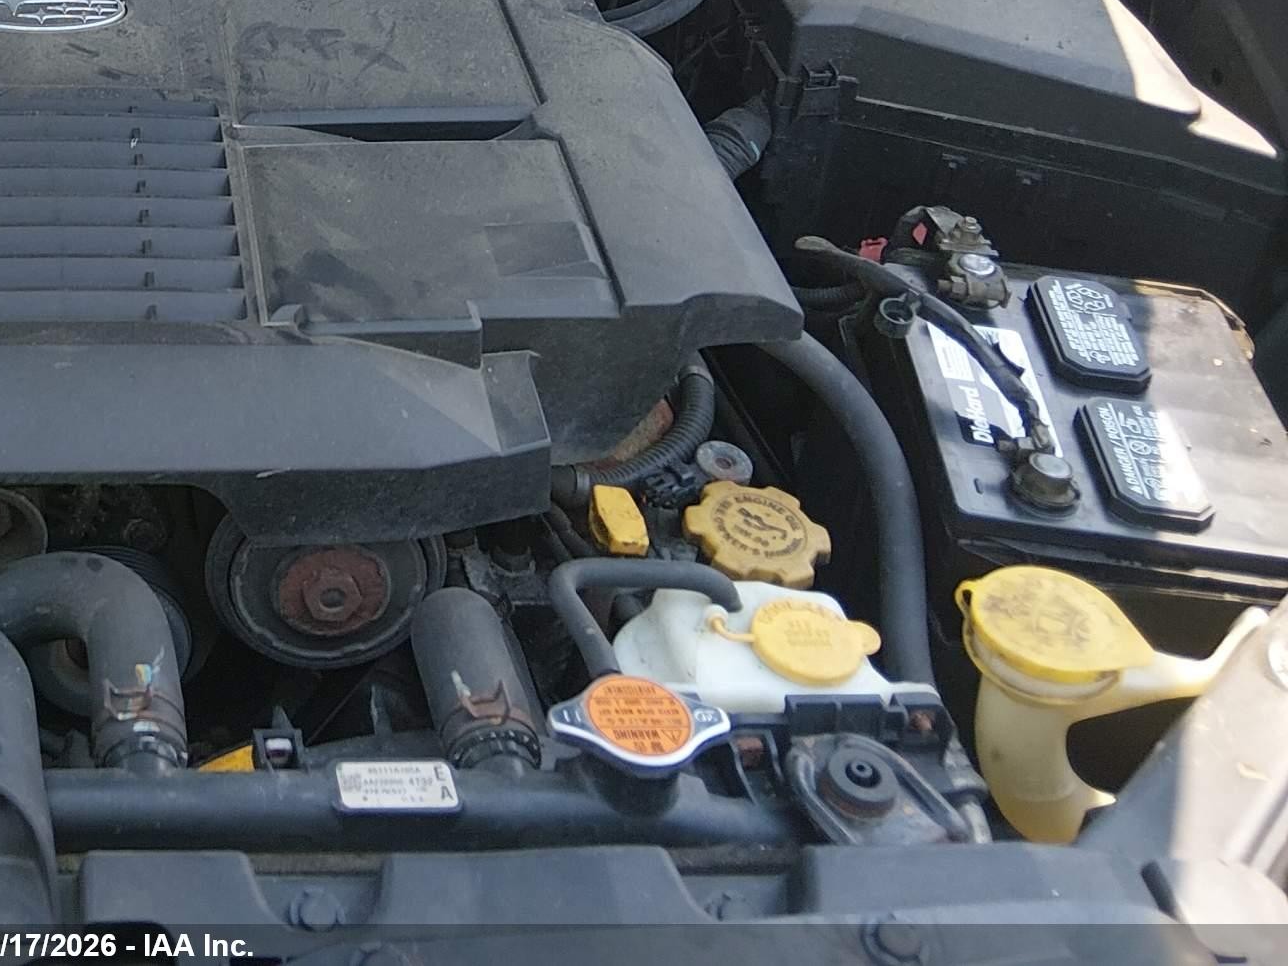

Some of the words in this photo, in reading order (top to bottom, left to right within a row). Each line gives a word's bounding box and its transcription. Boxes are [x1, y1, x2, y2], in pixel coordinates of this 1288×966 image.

[613, 729, 661, 740] WARNING
[434, 765, 447, 782] E
[440, 785, 454, 801] A
